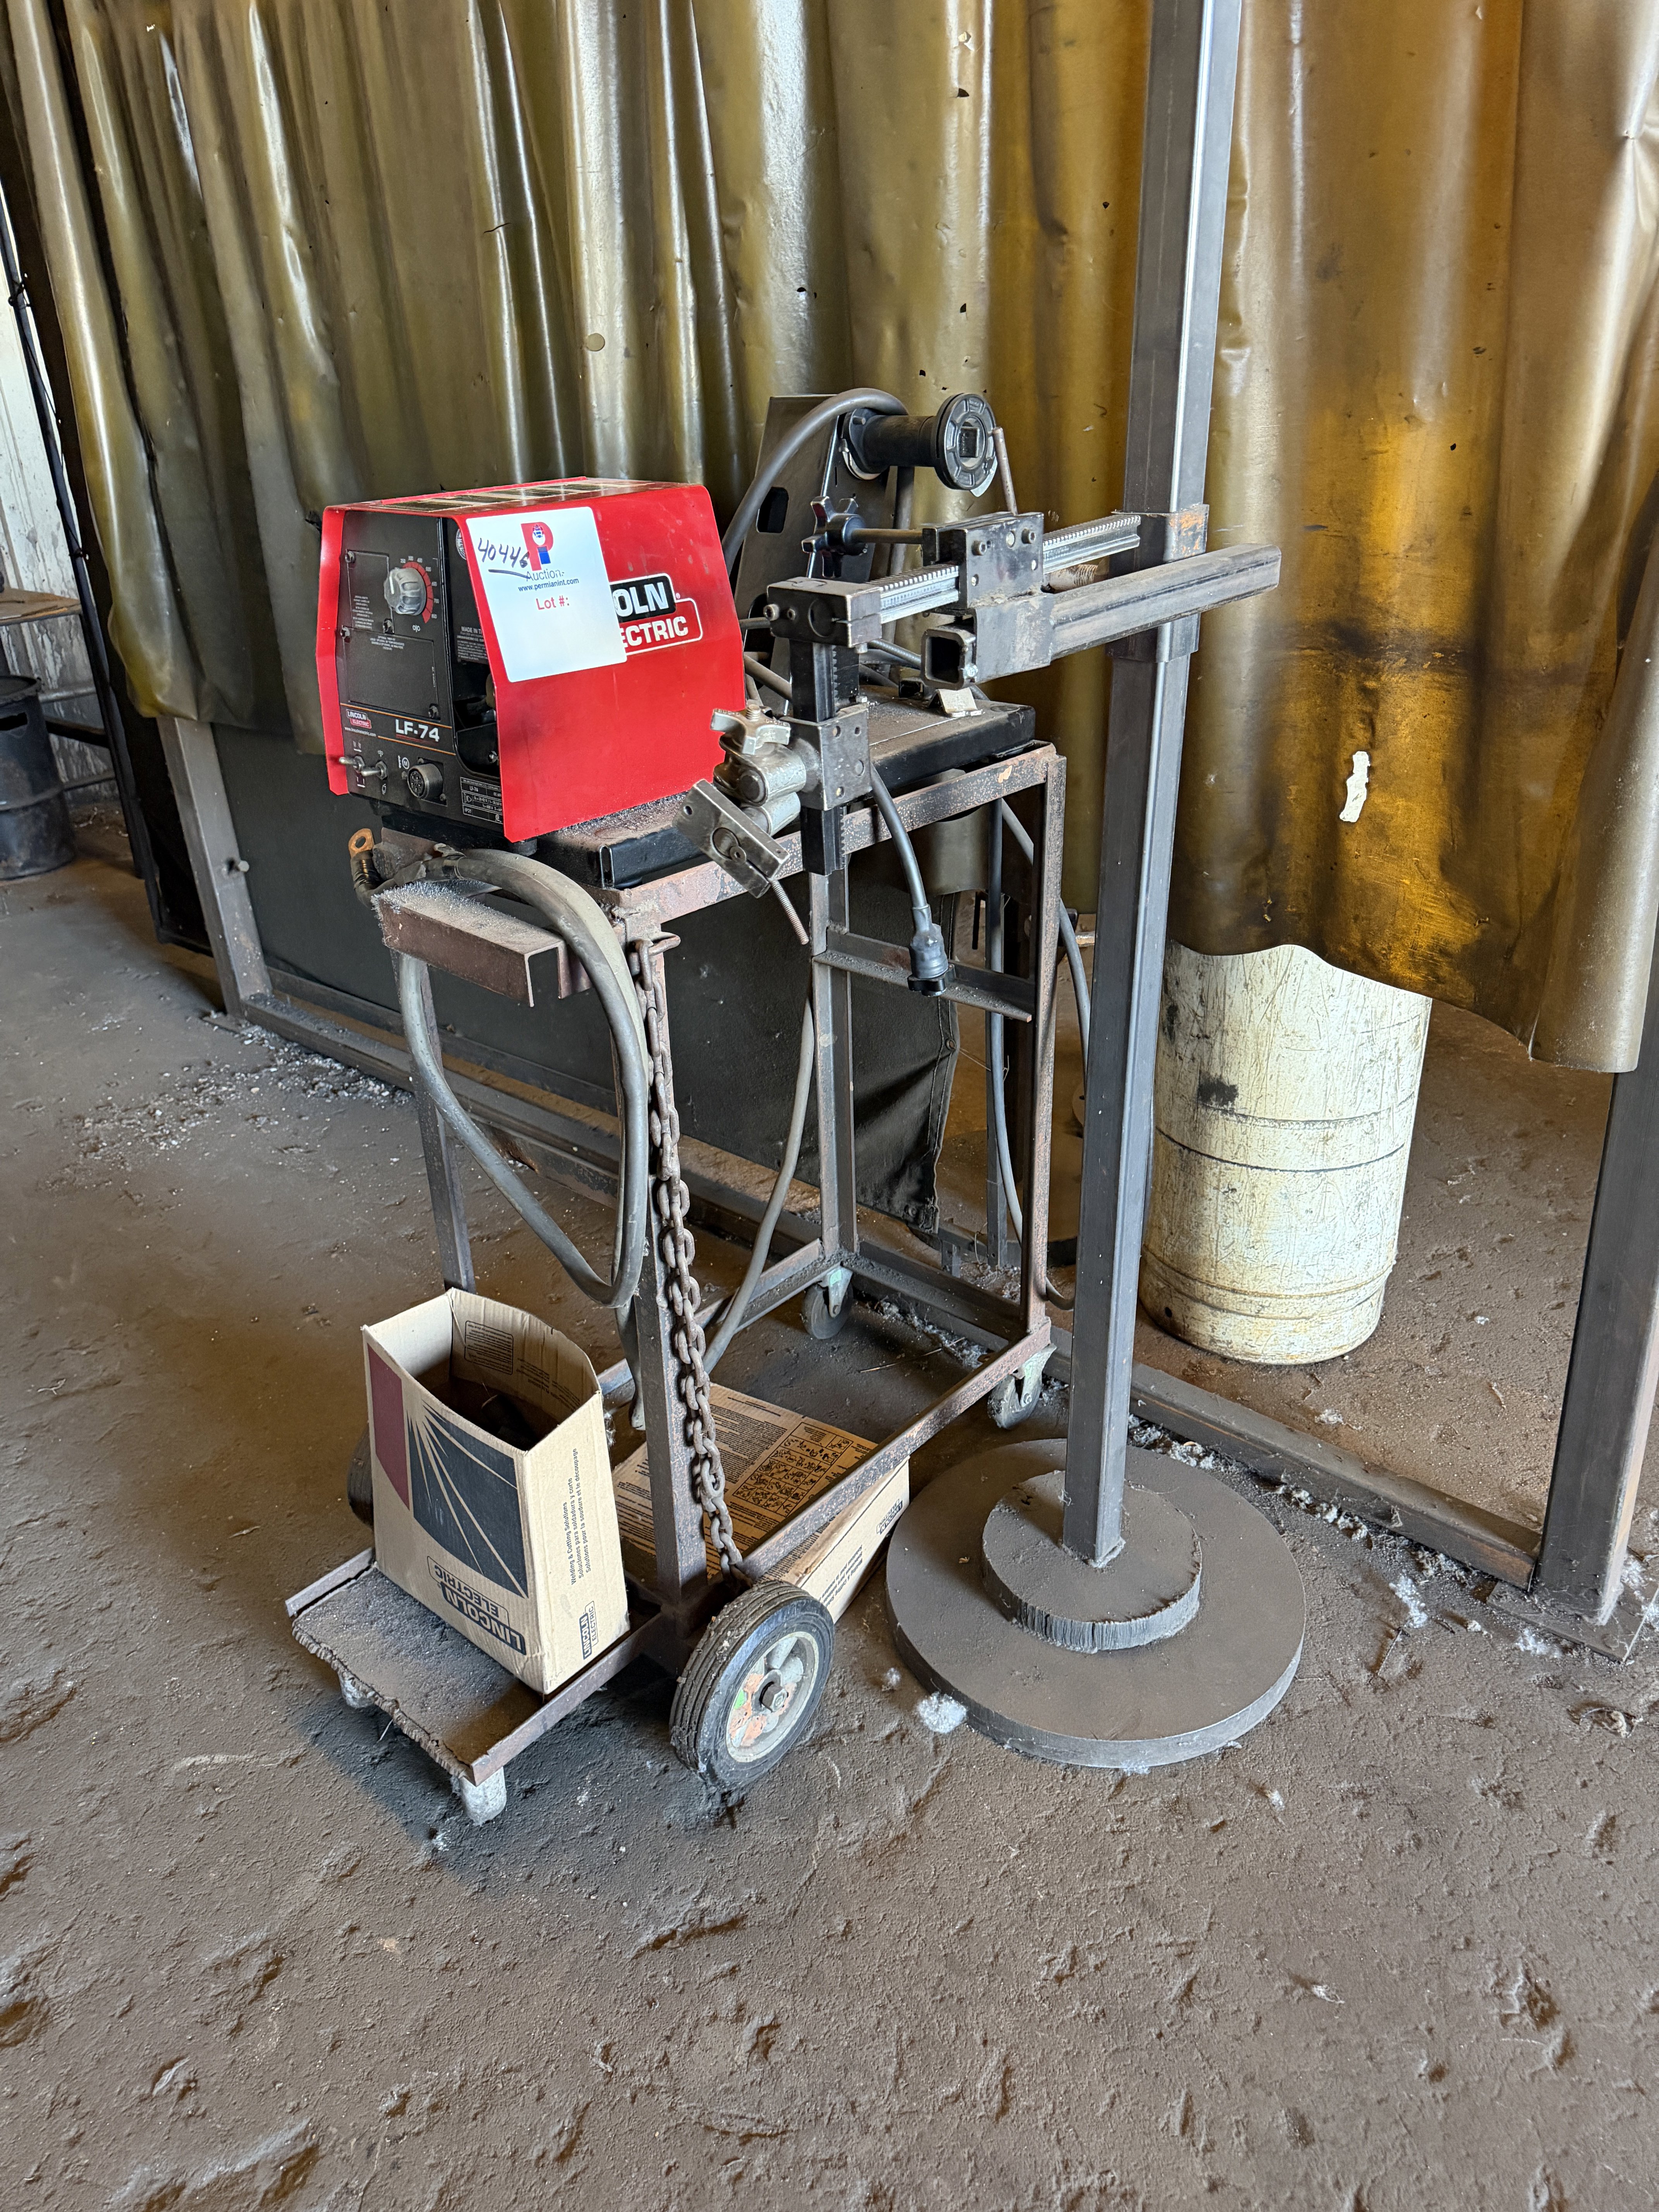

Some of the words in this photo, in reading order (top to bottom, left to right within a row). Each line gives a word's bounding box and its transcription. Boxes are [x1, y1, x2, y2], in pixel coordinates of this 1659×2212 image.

[478, 538, 530, 568] 40446
[536, 597, 556, 610] Lot
[558, 595, 570, 607] #:
[347, 711, 366, 720] LINCOLN
[395, 719, 440, 742] LF-74
[576, 1546, 584, 1579] Soluciones
[434, 1565, 500, 1618] ELECTRIC
[445, 1589, 522, 1650] LINCOLN
[581, 1615, 591, 1657] LINCOLN
[589, 1606, 597, 1642] ELECTRIC
